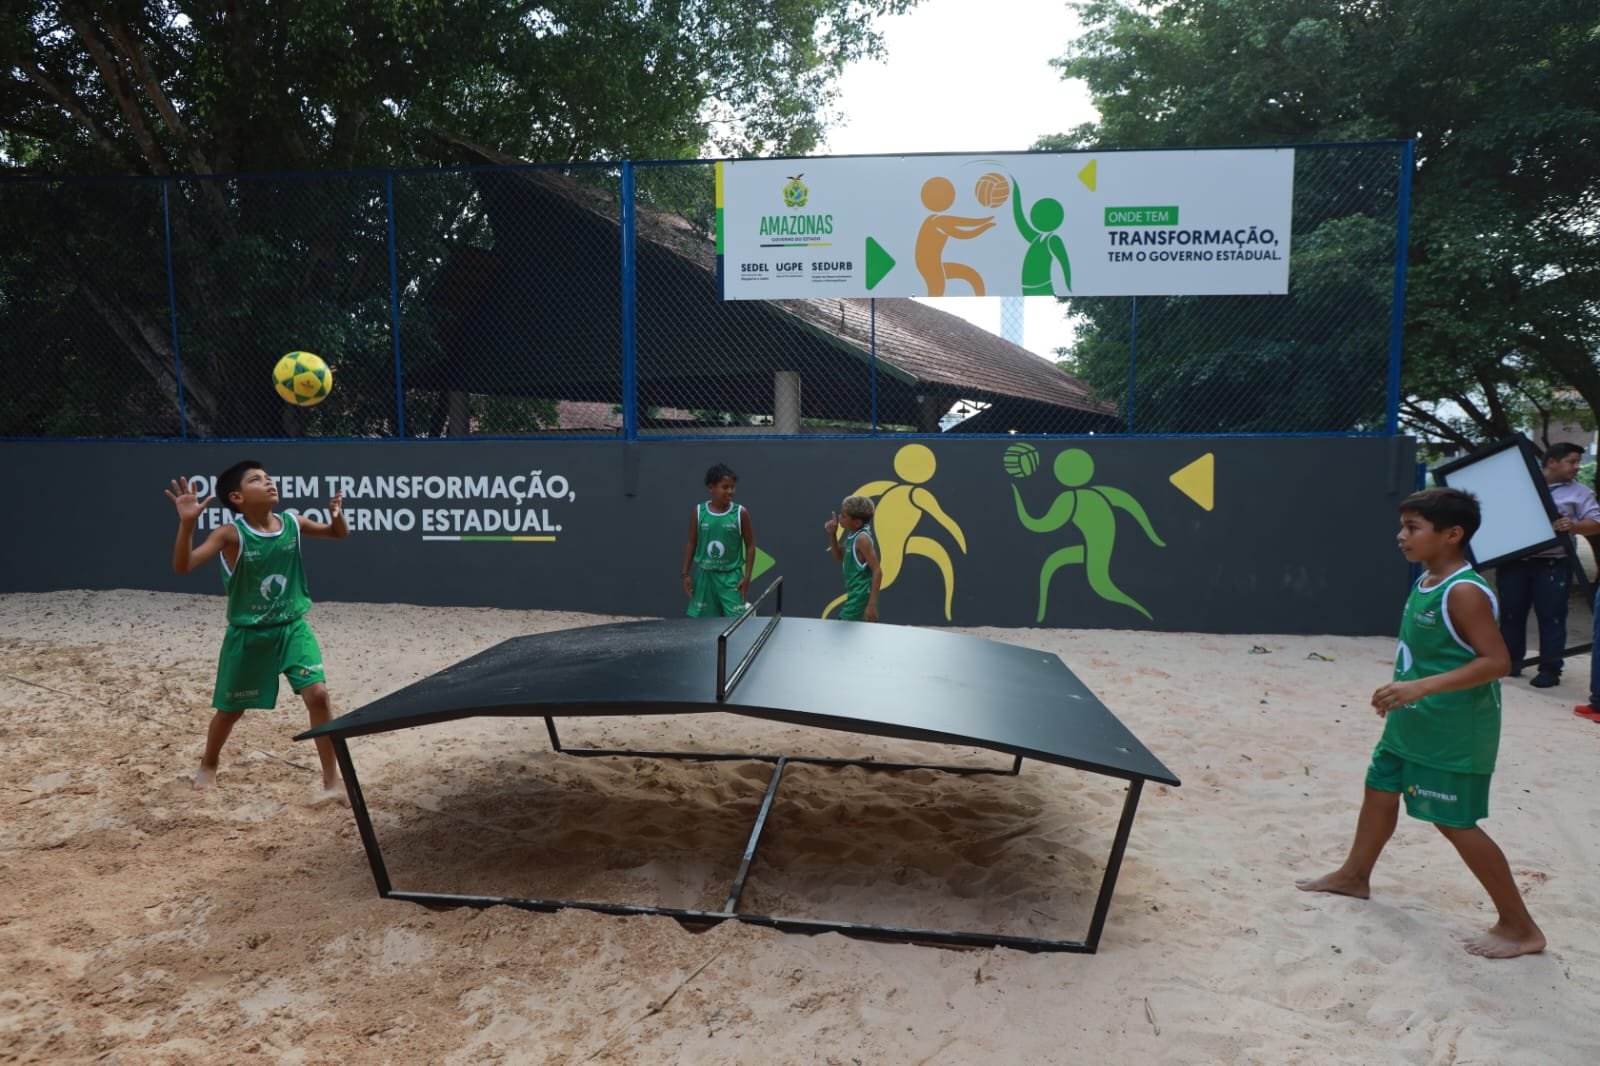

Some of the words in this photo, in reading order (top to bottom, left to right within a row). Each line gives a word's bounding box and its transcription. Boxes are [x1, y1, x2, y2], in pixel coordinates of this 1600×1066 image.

[760, 214, 833, 236] AMAZONAS
[1108, 211, 1142, 223] ONDE
[1146, 211, 1169, 222] TEM
[1108, 226, 1279, 248] TRANSFORMAÇÃO,
[741, 263, 769, 272] SEDEL
[776, 262, 803, 271] UGPE
[811, 261, 853, 271] SEDURB
[1108, 251, 1133, 262] TEM
[1136, 251, 1146, 262] O
[1149, 250, 1213, 262] GOVERNO
[1216, 250, 1281, 261] ESTADUAL.
[325, 470, 575, 505] TRANSFORMAÇÃO,
[422, 509, 562, 532] ESTADUAL.
